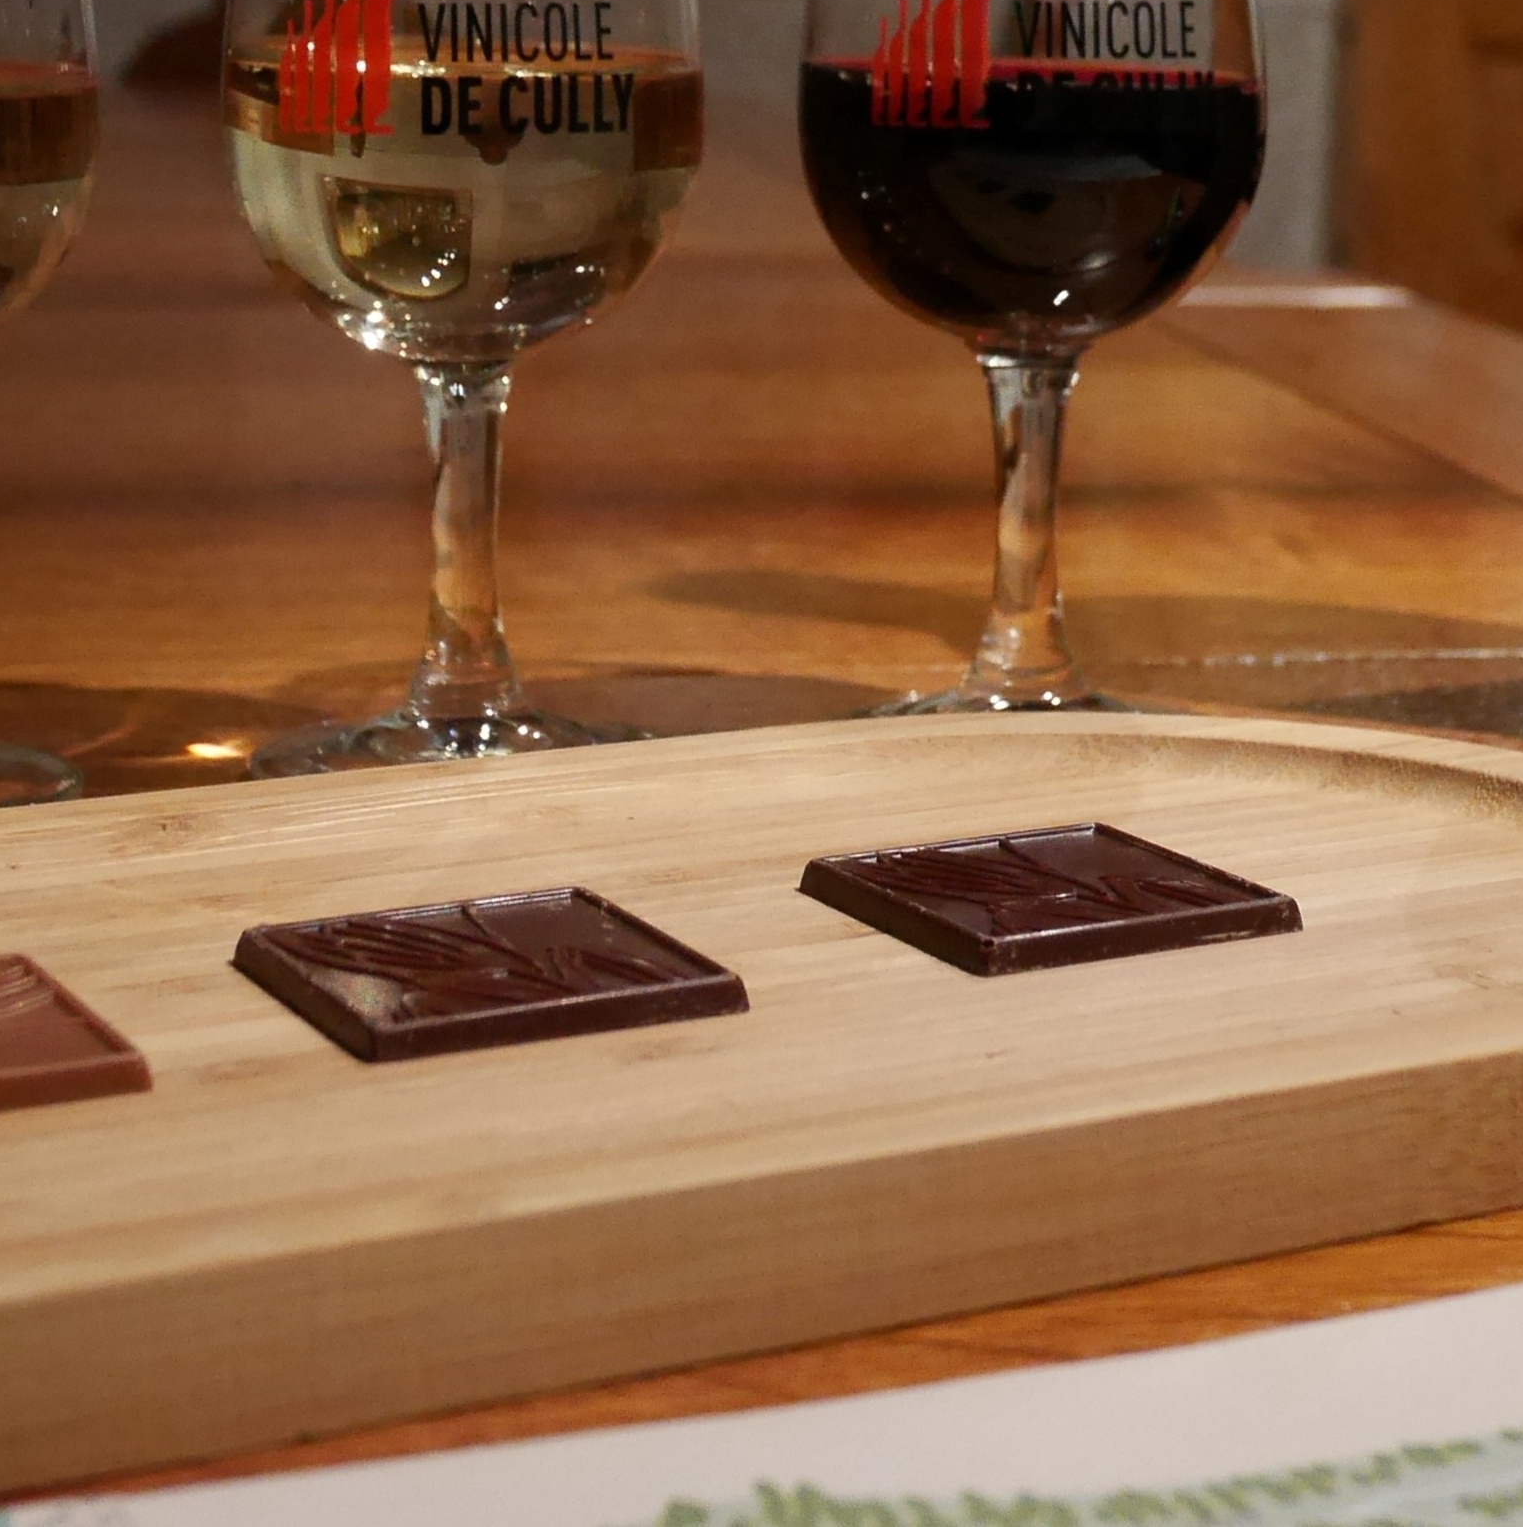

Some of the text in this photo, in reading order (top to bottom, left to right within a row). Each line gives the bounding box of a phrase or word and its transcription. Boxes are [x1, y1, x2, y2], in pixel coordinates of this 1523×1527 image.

[418, 3, 614, 61] VINICOLE
[1013, 1, 1196, 59] VINICOLE
[421, 74, 634, 135] DE CULLY
